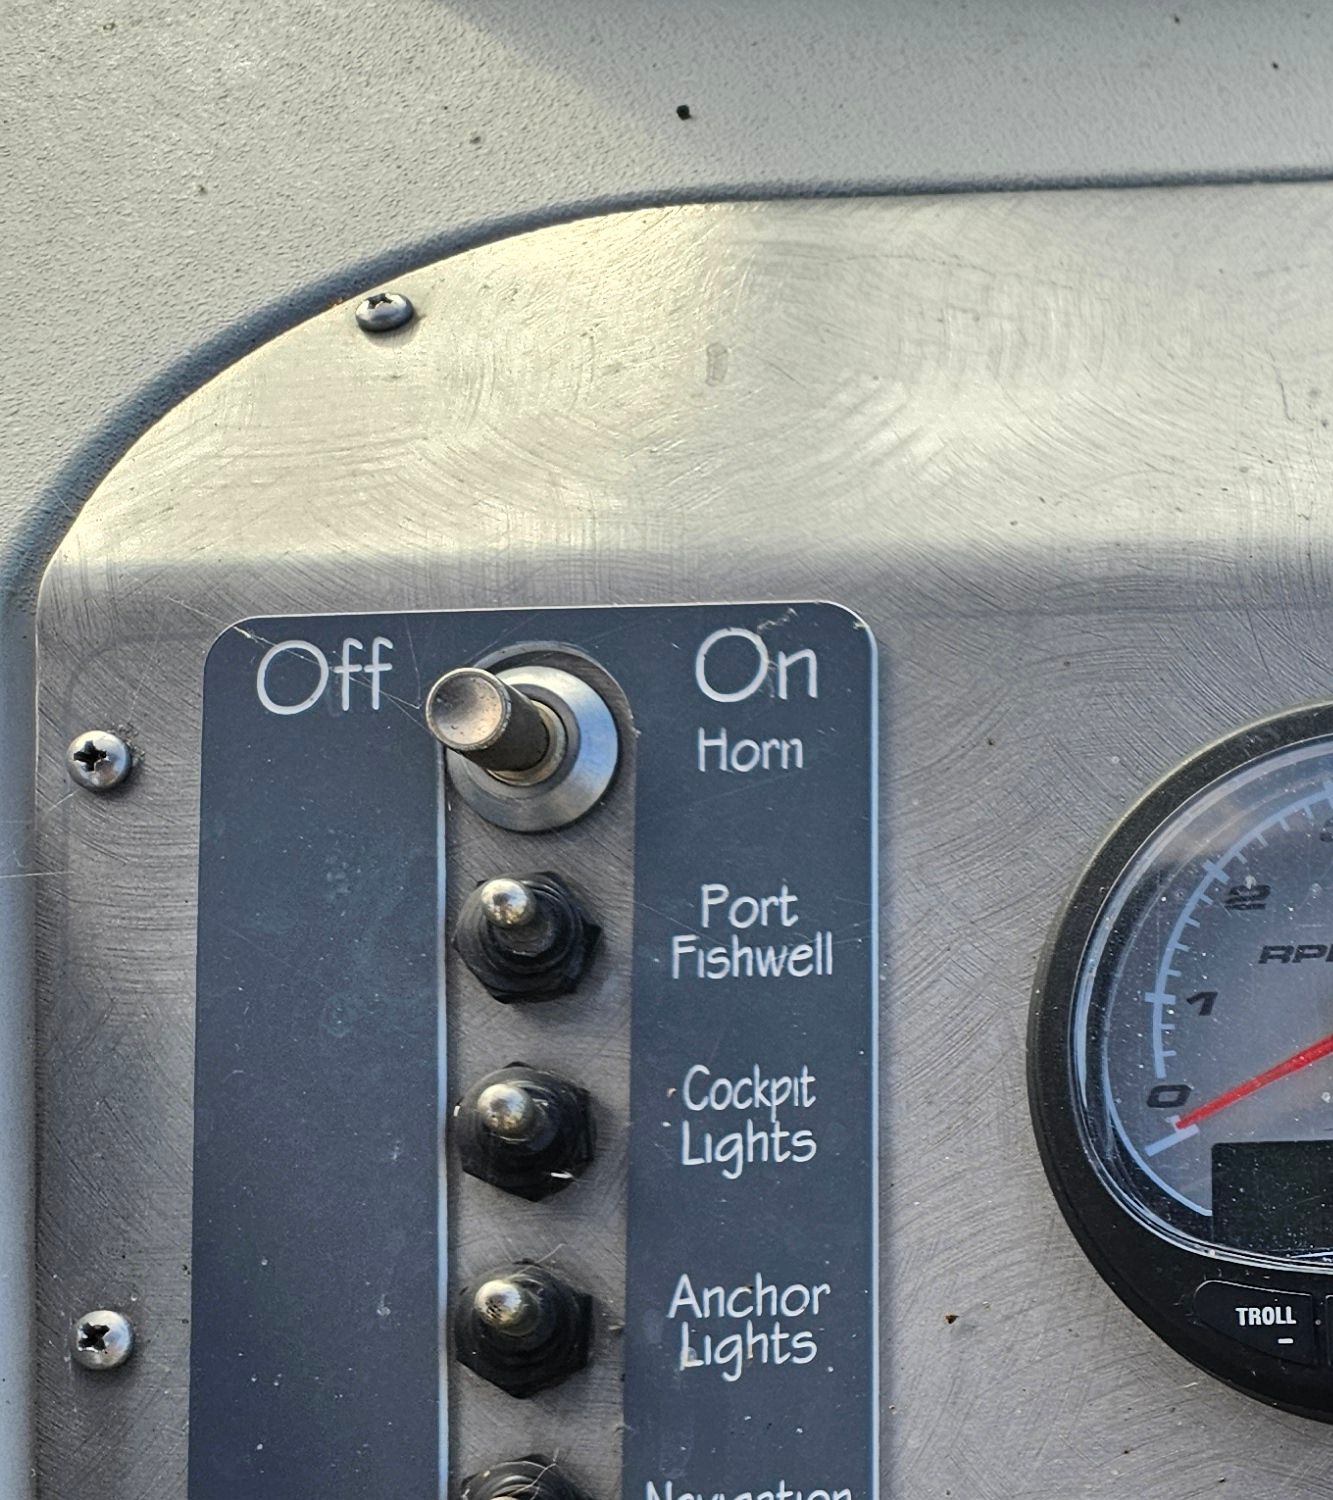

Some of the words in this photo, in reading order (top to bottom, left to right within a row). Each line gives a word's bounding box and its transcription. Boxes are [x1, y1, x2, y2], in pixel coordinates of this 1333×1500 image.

[257, 637, 394, 715] Off
[696, 627, 818, 703] On
[698, 727, 803, 773] Horn
[701, 883, 798, 928] Port
[1225, 884, 1271, 910] 2
[671, 932, 833, 979] Fishwell
[1187, 991, 1219, 1016] 1
[683, 1065, 816, 1123] Cockpit
[1146, 1084, 1192, 1108] 0
[681, 1121, 817, 1180] Lights
[667, 1272, 831, 1319] Anchor
[1235, 1305, 1296, 1327] TROLL
[679, 1322, 818, 1381] Lights
